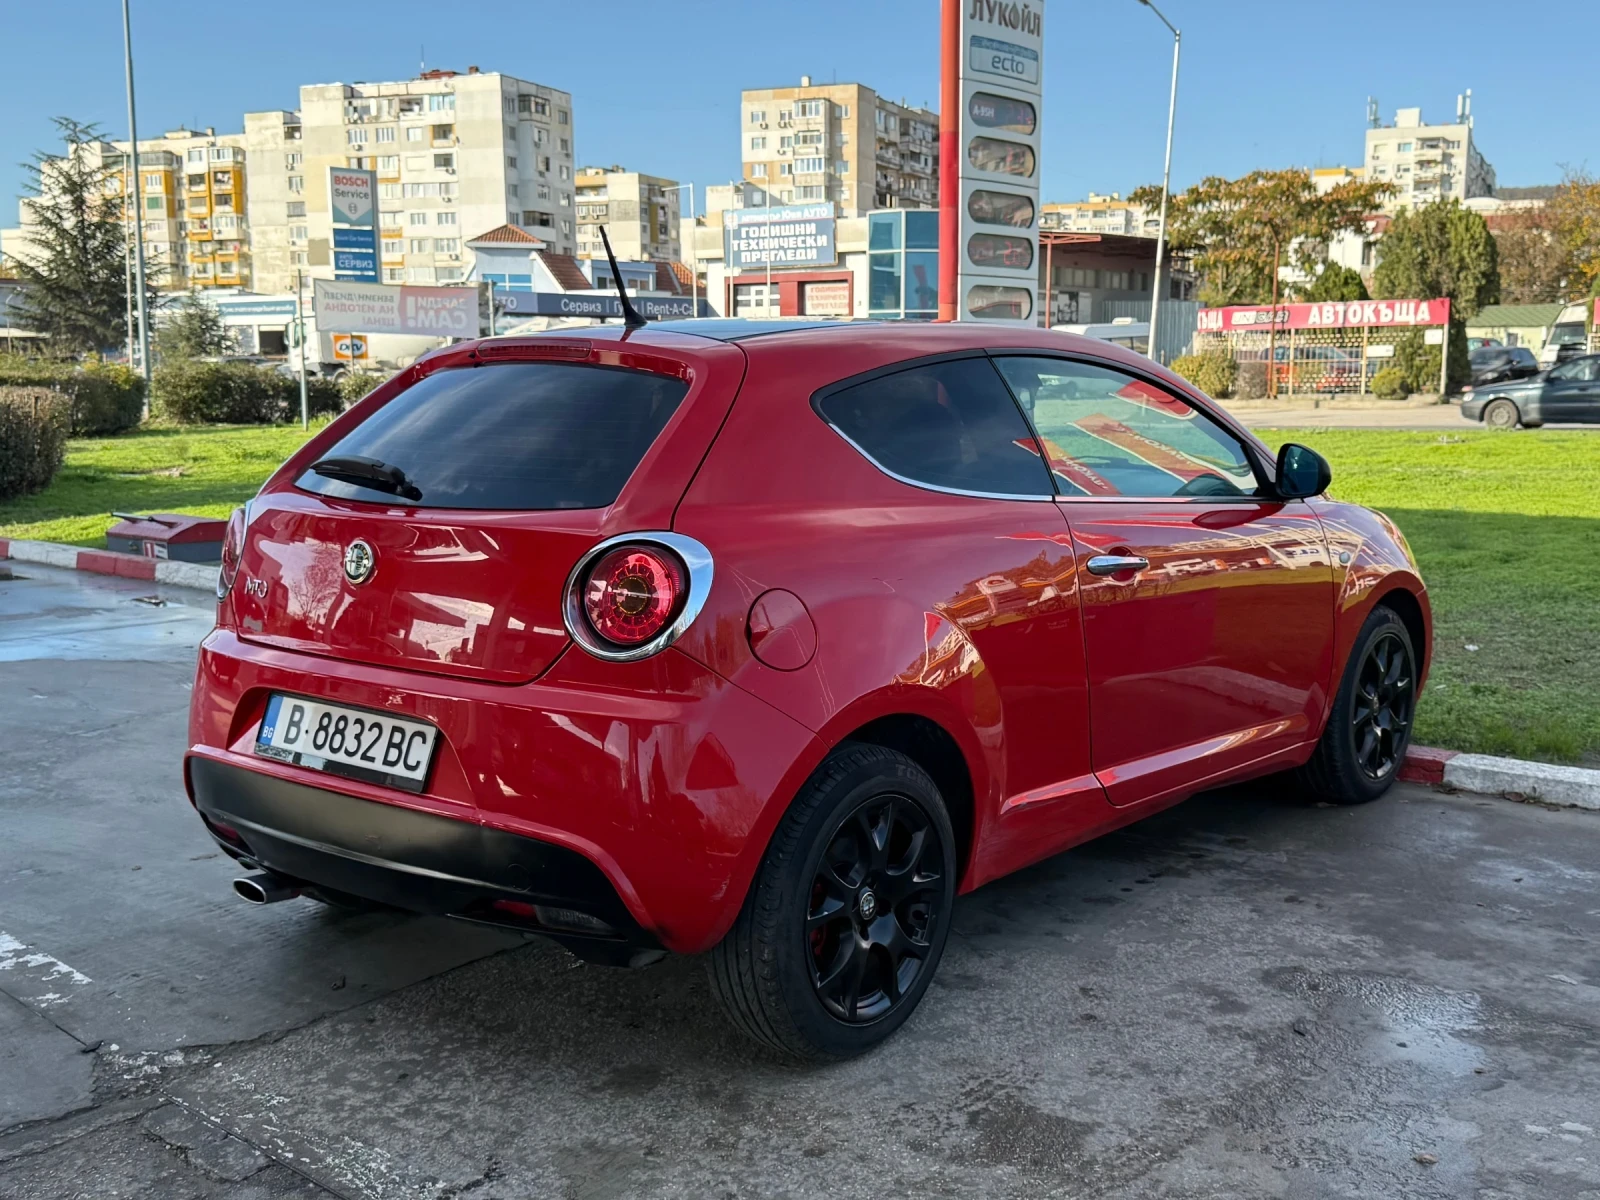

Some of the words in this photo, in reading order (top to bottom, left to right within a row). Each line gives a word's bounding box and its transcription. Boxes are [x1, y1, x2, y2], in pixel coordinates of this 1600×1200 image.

[991, 55, 1025, 75] ecto
[334, 175, 369, 188] BOSCH
[335, 188, 370, 200] Service
[740, 222, 817, 239] ГОДИШНИ
[732, 234, 828, 252] ТЕХНИЧЕСКИ
[740, 248, 818, 263] ПРЕГЛЕДИ
[338, 259, 374, 269] СЕРВИЗ
[560, 298, 602, 314] Сервиз
[646, 302, 694, 316] Rent-A-Ca
[1306, 301, 1432, 327] АВТОКЪЩА
[262, 725, 274, 739] BG
